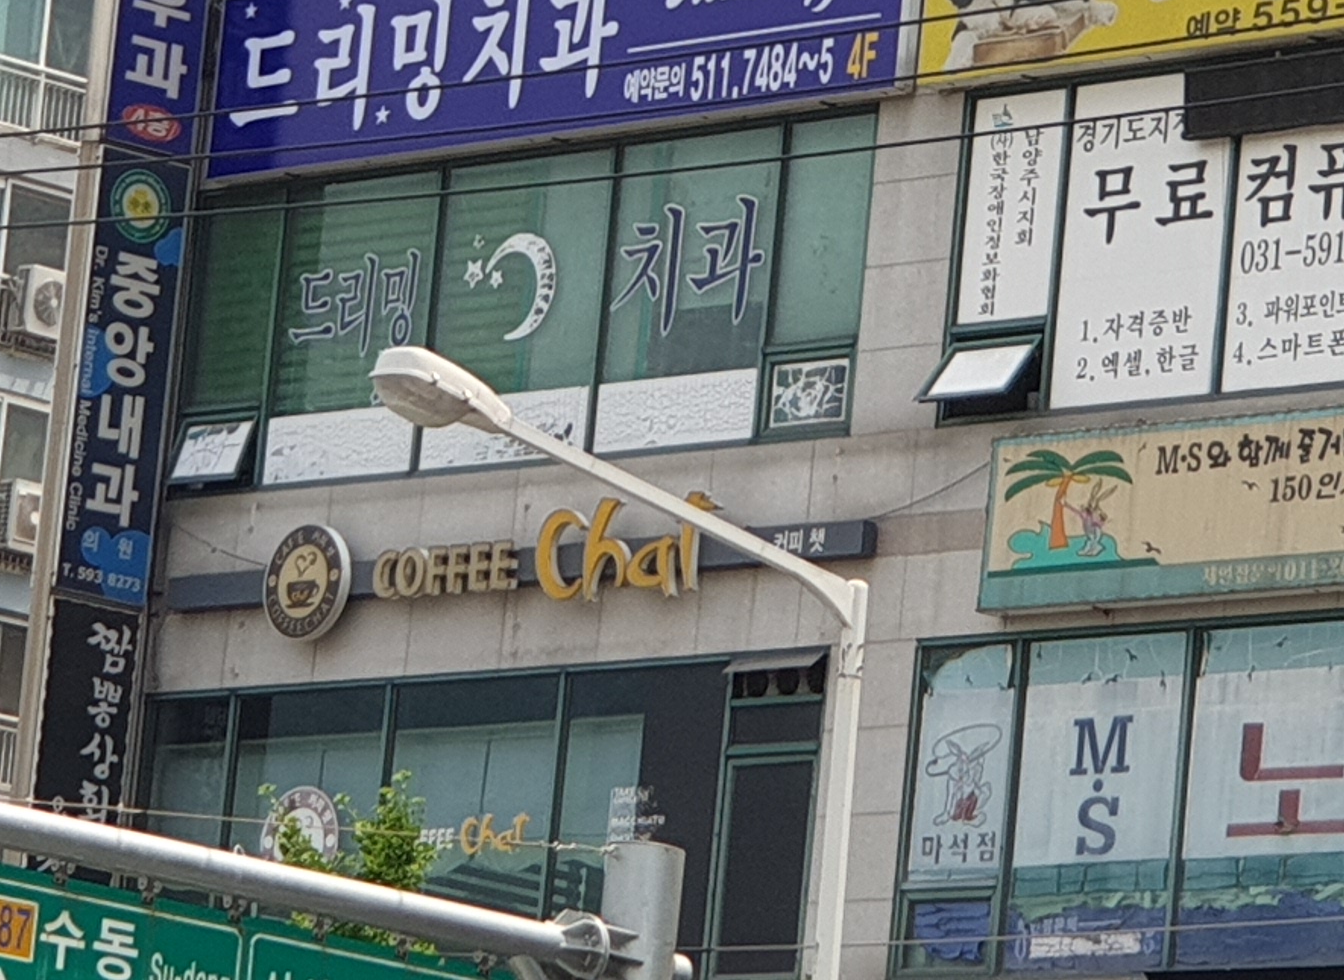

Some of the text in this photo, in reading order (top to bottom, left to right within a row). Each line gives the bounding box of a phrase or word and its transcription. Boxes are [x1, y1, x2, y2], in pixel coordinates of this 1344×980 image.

[1186, 6, 1242, 40] 예약
[623, 62, 686, 103] 예약문의
[846, 31, 880, 80] 4F
[1084, 160, 1215, 245] 무료
[609, 194, 766, 337] 치과
[287, 247, 422, 359] 드리밍
[1236, 302, 1254, 327] 3.
[86, 250, 161, 528] 중앙내과
[1237, 431, 1292, 468] 함께
[77, 565, 105, 585] 593
[82, 529, 135, 562] 의원
[371, 539, 519, 599] COFFEE
[921, 831, 997, 865] 마석점
[39, 908, 140, 980] 수동
